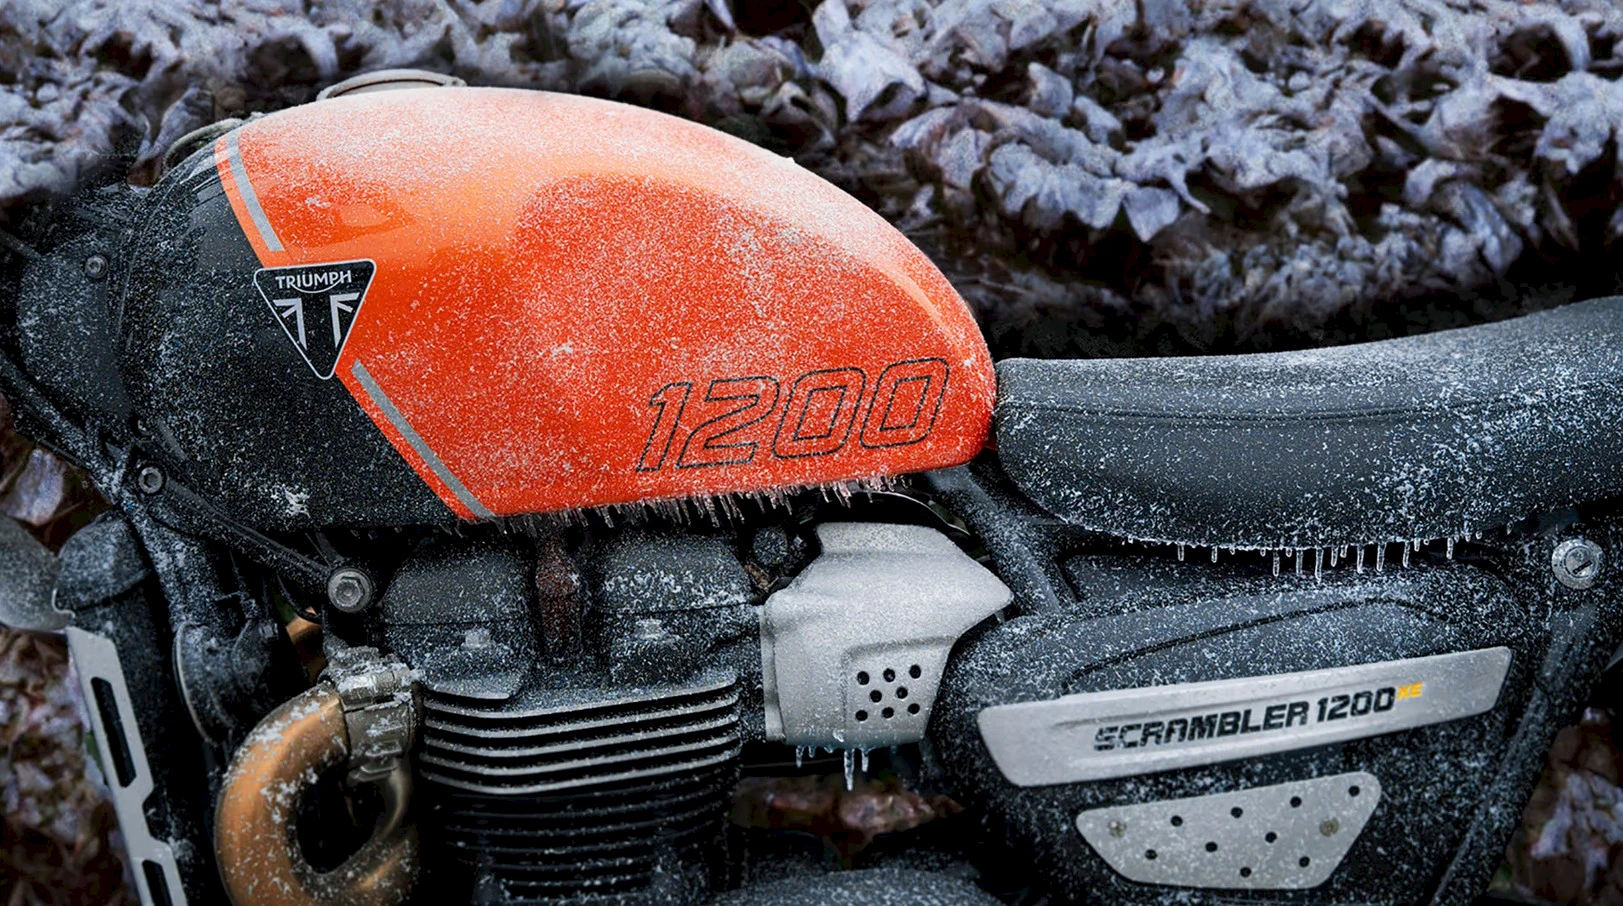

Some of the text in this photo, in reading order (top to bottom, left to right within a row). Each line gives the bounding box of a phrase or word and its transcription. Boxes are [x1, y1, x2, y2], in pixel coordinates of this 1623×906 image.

[275, 270, 352, 292] TRIUMPH
[636, 357, 949, 472] 1200
[1094, 702, 1309, 751] SCRAMBLER
